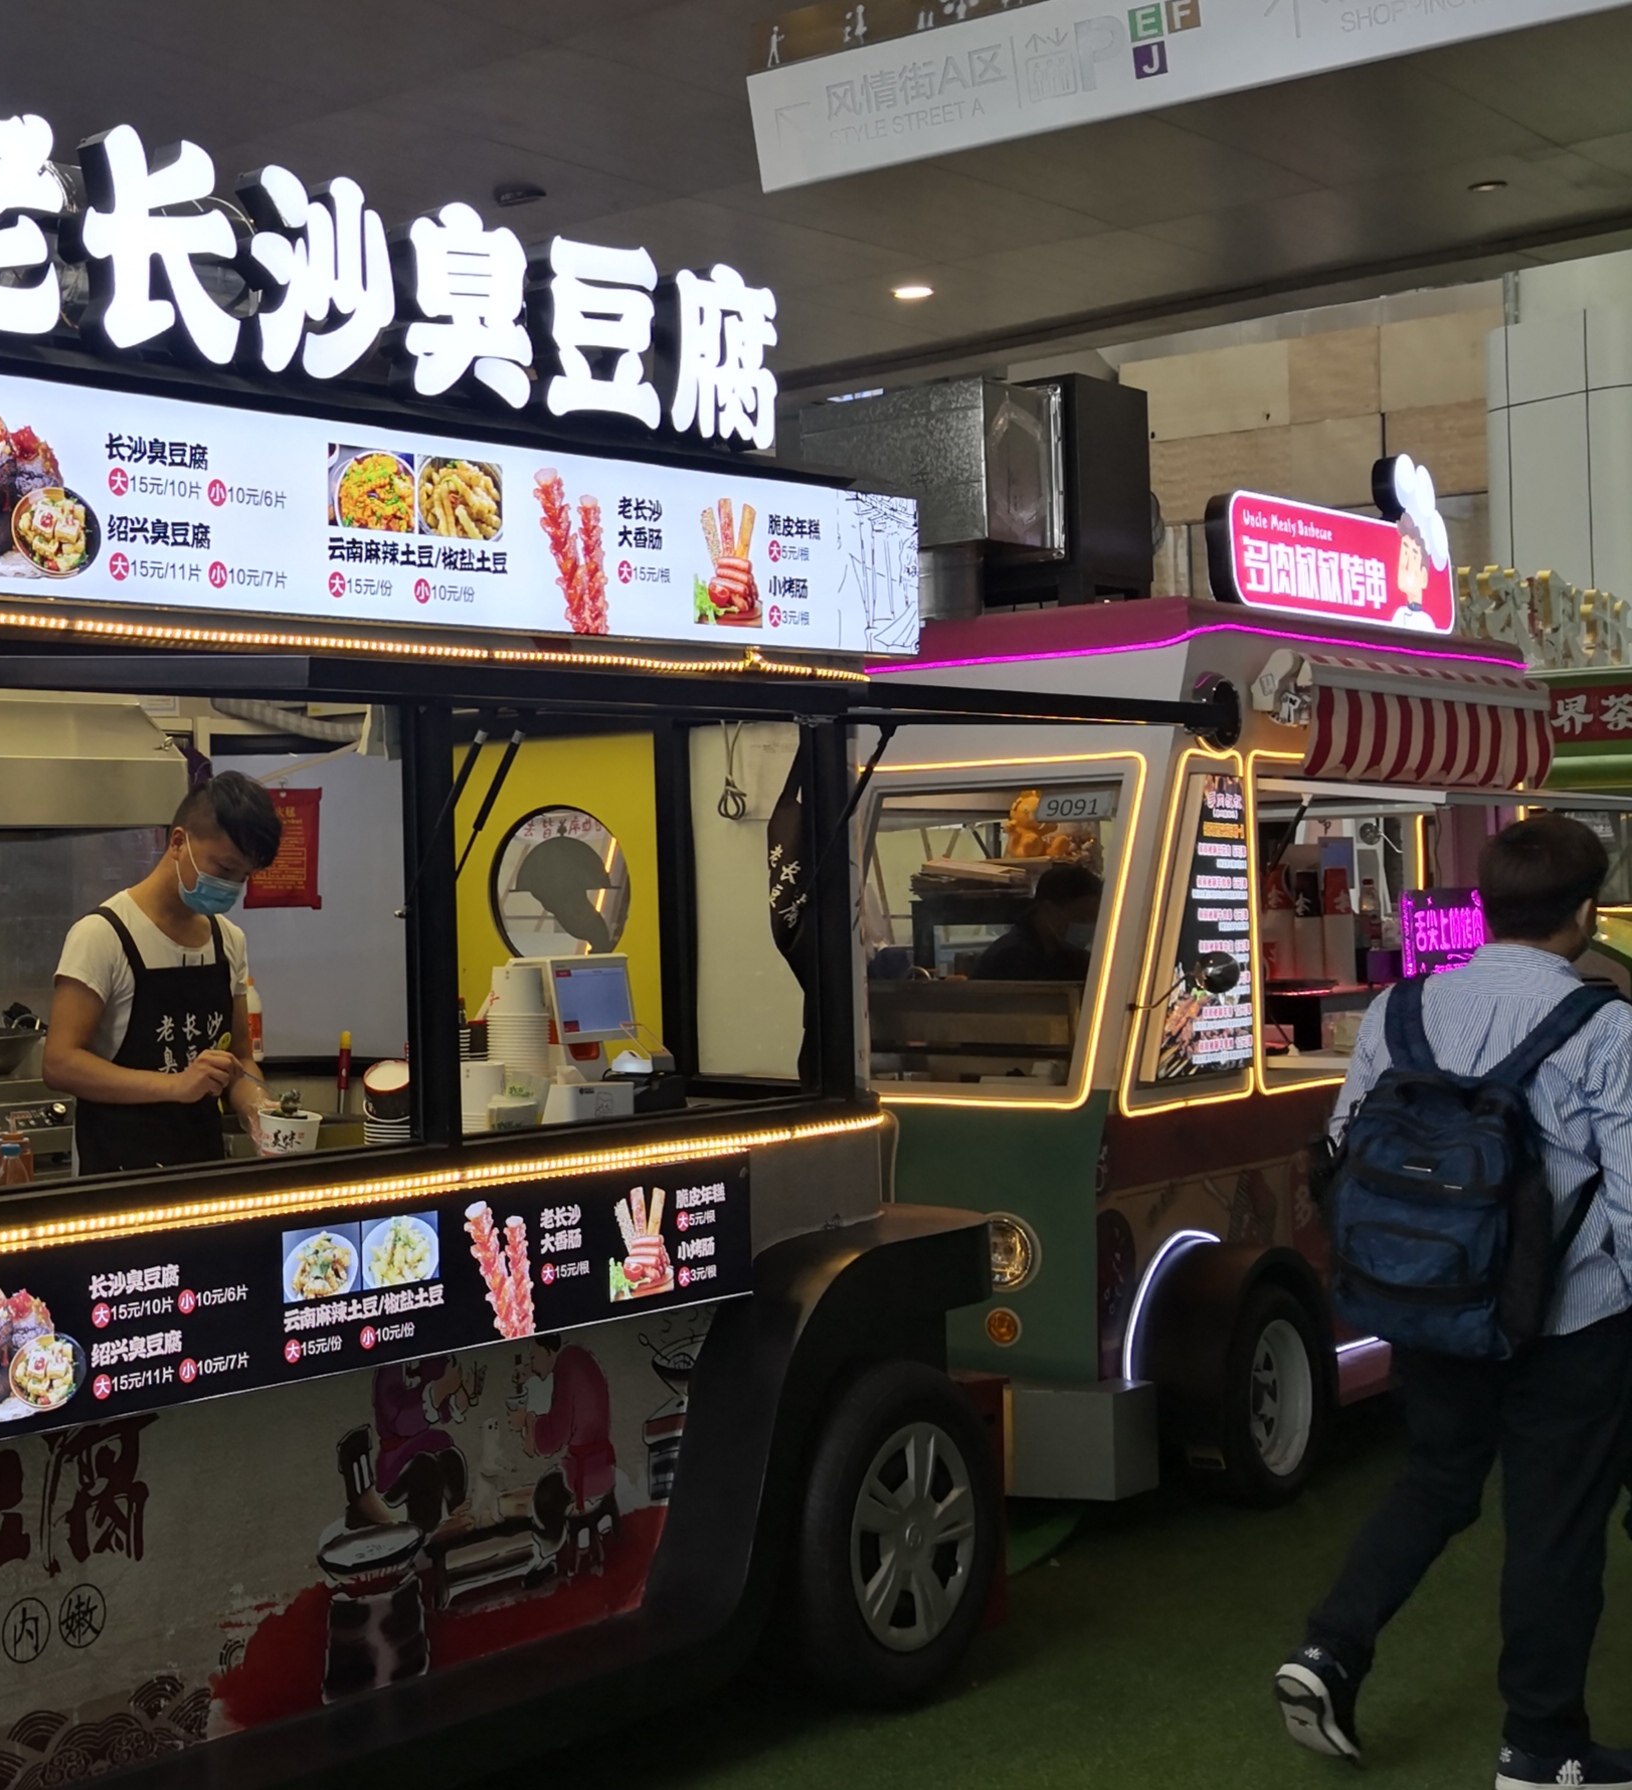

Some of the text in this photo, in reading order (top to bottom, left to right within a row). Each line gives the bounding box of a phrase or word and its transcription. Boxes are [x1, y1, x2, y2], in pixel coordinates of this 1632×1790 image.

[1135, 7, 1159, 37] E
[1142, 44, 1161, 75] J
[825, 43, 1008, 122] 风情街A区
[829, 97, 986, 149] STYLE STREET A
[105, 433, 208, 470] 长沙臭豆腐
[618, 496, 662, 522] 老长沙
[1242, 508, 1268, 529] Uncle
[1297, 519, 1333, 542] Barbecue
[108, 514, 210, 549] 绍兴臭豆腐
[618, 525, 662, 551] 大香肠
[768, 514, 821, 541] 脆皮年糕
[328, 536, 508, 574] 云南麻辣土豆/椒盐土豆
[768, 575, 808, 599] 小烤肠
[1242, 534, 1387, 610] 多肉叔叔烤串
[1046, 797, 1099, 818] 9091
[155, 1011, 223, 1044] 老长沙
[675, 1182, 726, 1209] 脆皮年糕
[540, 1204, 581, 1229] 老长沙
[540, 1229, 582, 1255] 大香肠
[677, 1235, 715, 1261] 小烤肠
[88, 1264, 179, 1301] 长沙臭豆腐
[283, 1284, 445, 1333] 云南麻辣土豆/椒盐土豆
[91, 1330, 183, 1368] 绍兴臭豆腐
